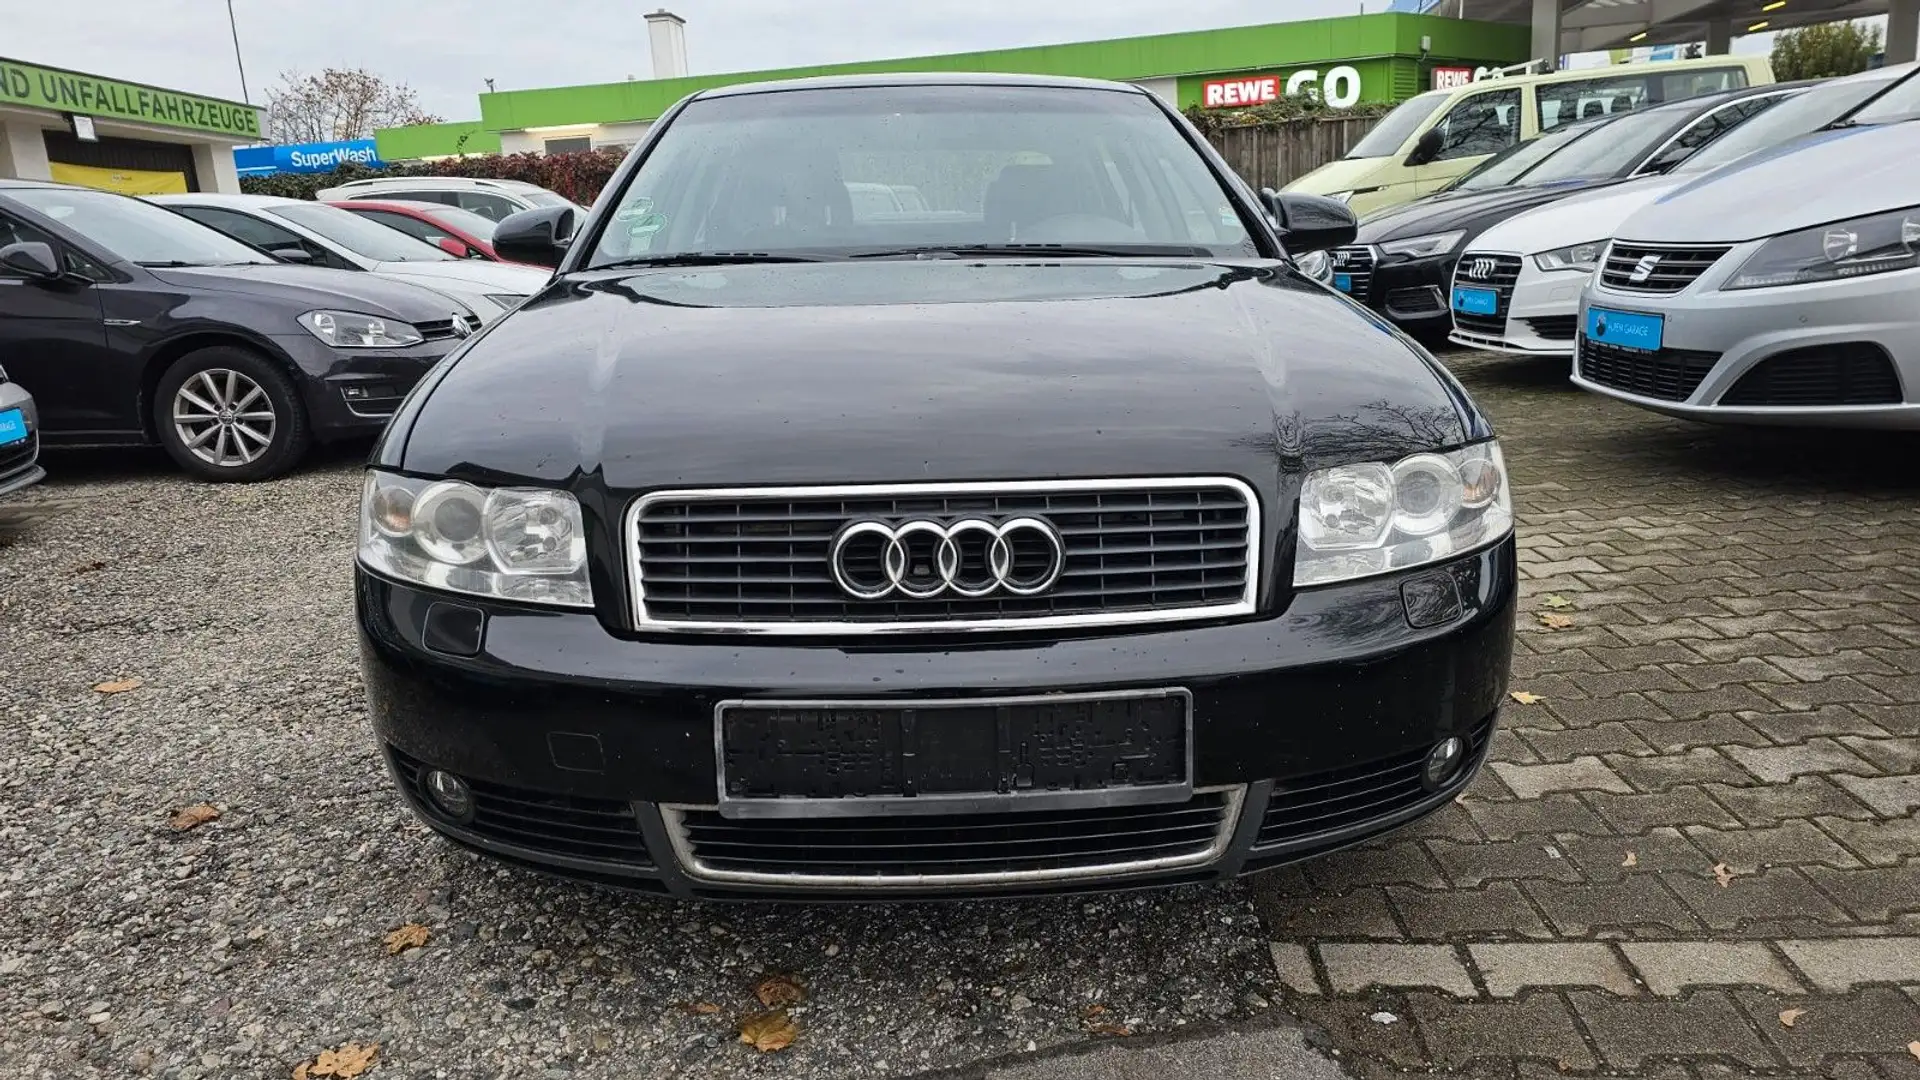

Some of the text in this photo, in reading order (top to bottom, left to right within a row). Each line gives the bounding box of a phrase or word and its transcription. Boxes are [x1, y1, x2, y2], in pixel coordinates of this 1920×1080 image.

[1207, 79, 1276, 105] REWE
[1436, 70, 1469, 91] REWE
[39, 73, 257, 133] UNFALLFAHRZEUGE
[291, 147, 377, 169] SuperWash
